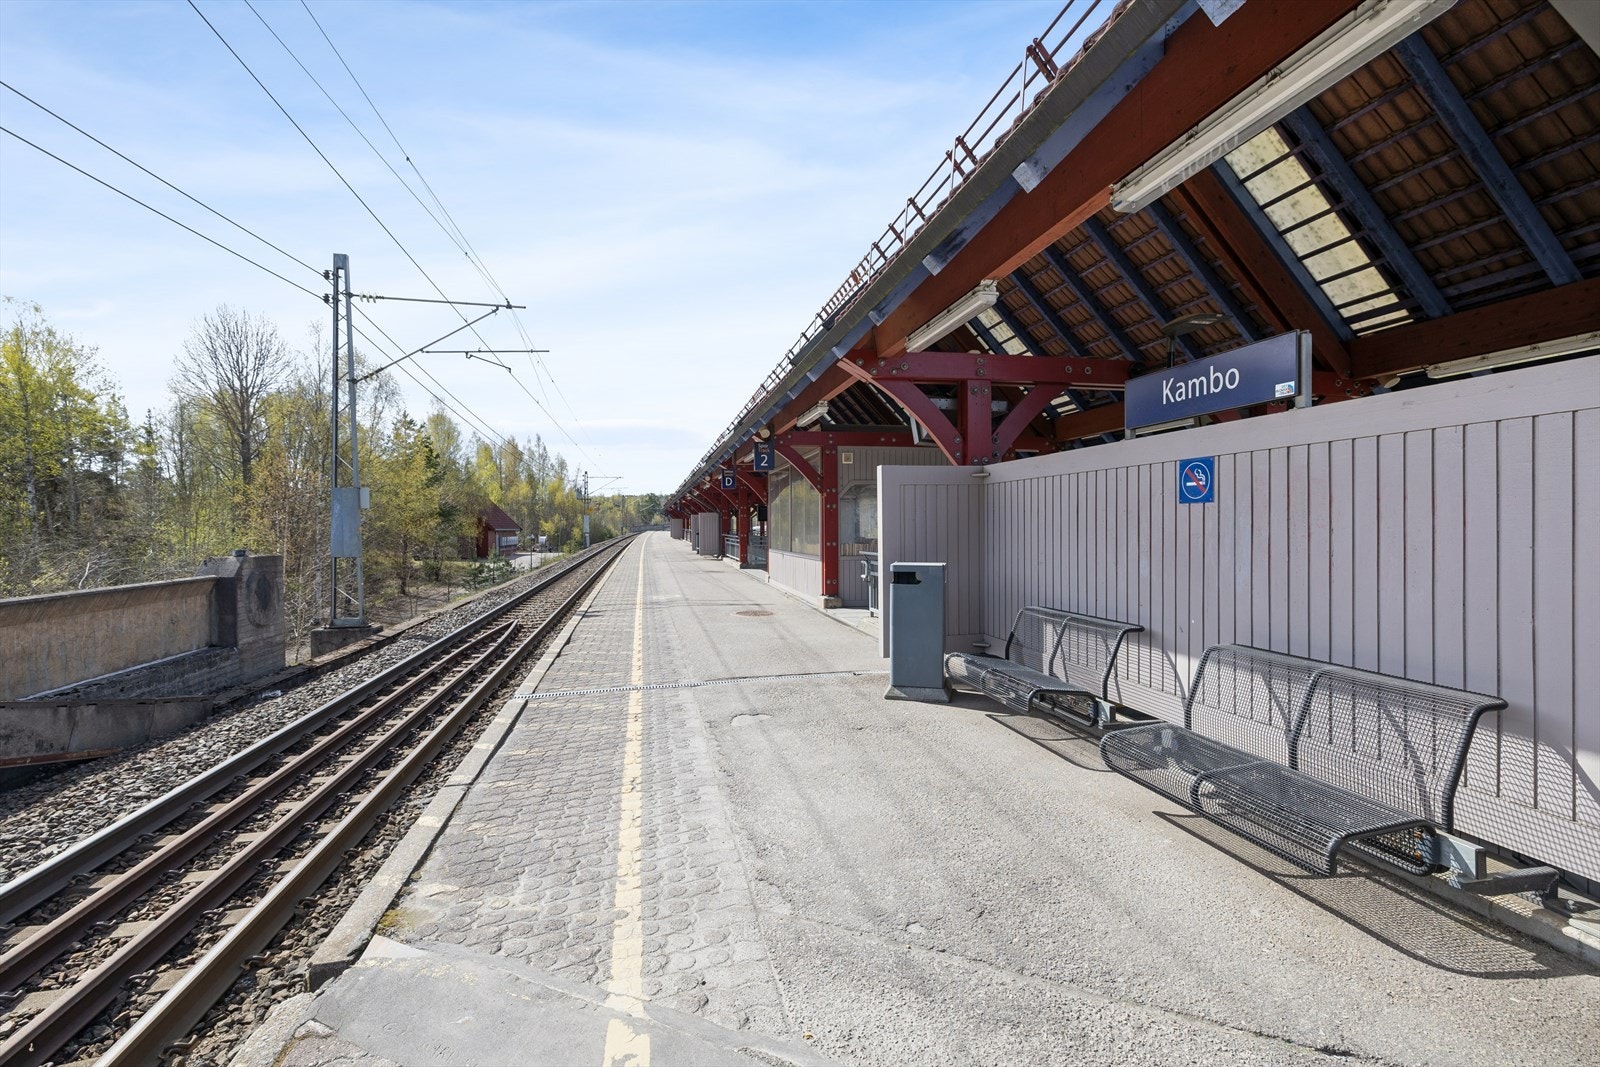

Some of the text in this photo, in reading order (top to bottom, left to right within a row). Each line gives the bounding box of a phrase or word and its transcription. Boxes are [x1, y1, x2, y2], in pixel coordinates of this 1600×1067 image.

[1163, 366, 1240, 404] Kambo
[760, 454, 768, 466] 2
[726, 478, 732, 486] D
